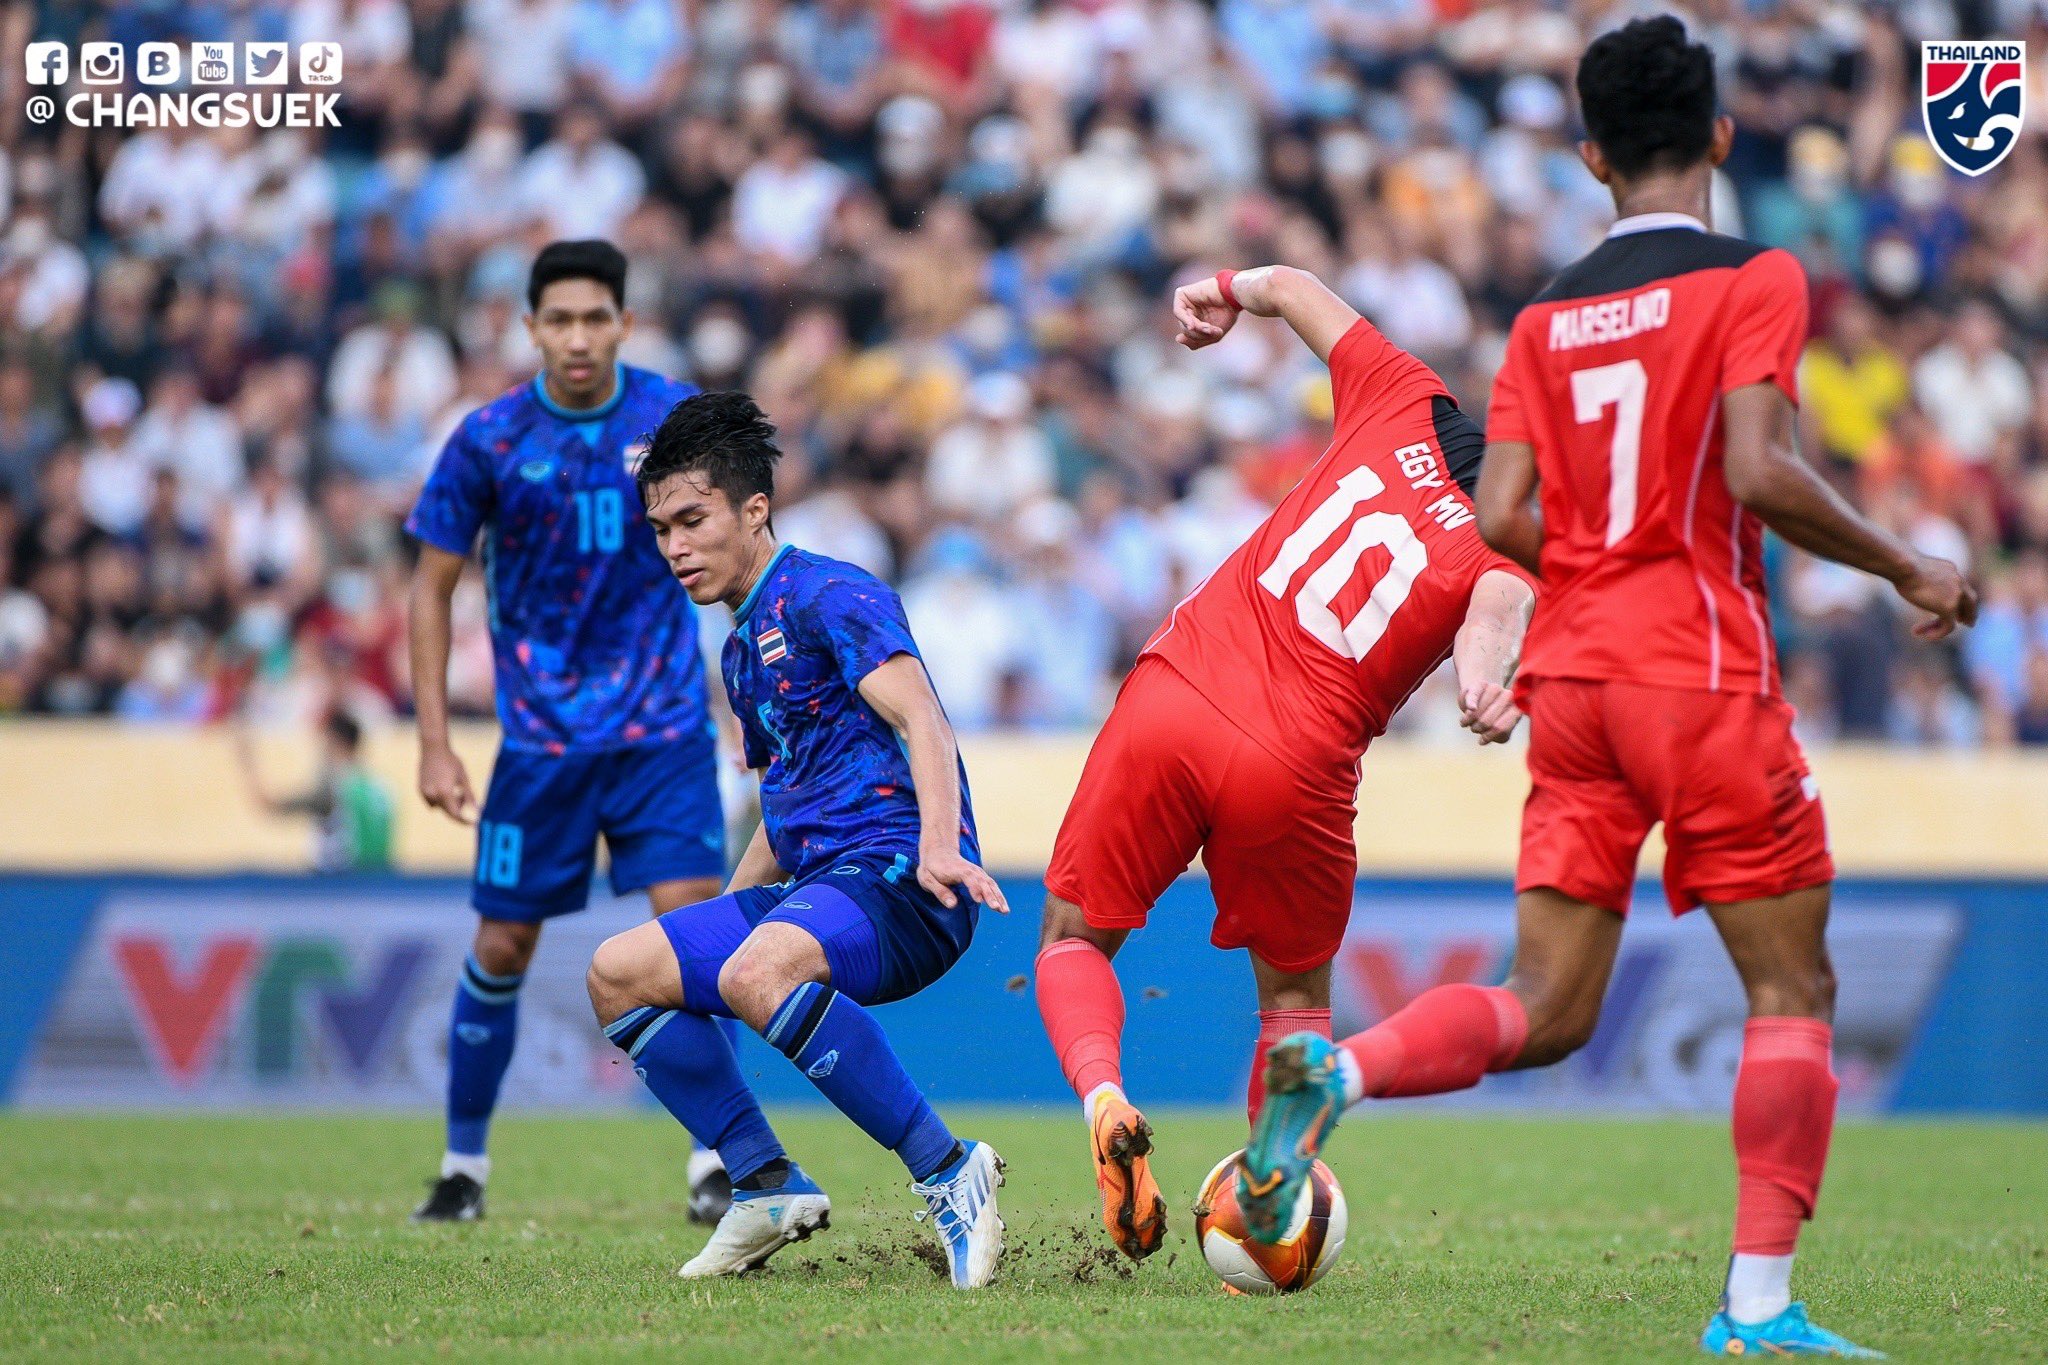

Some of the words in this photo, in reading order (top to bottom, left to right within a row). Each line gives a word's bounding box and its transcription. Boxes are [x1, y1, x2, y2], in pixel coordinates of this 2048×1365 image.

[1394, 441, 1445, 491] EGY
[1424, 493, 1477, 532] MV
[1569, 358, 1648, 551] 7
[573, 487, 624, 555] 18
[1256, 464, 1429, 665] 10
[476, 820, 524, 889] 18
[113, 932, 436, 1087] VTV
